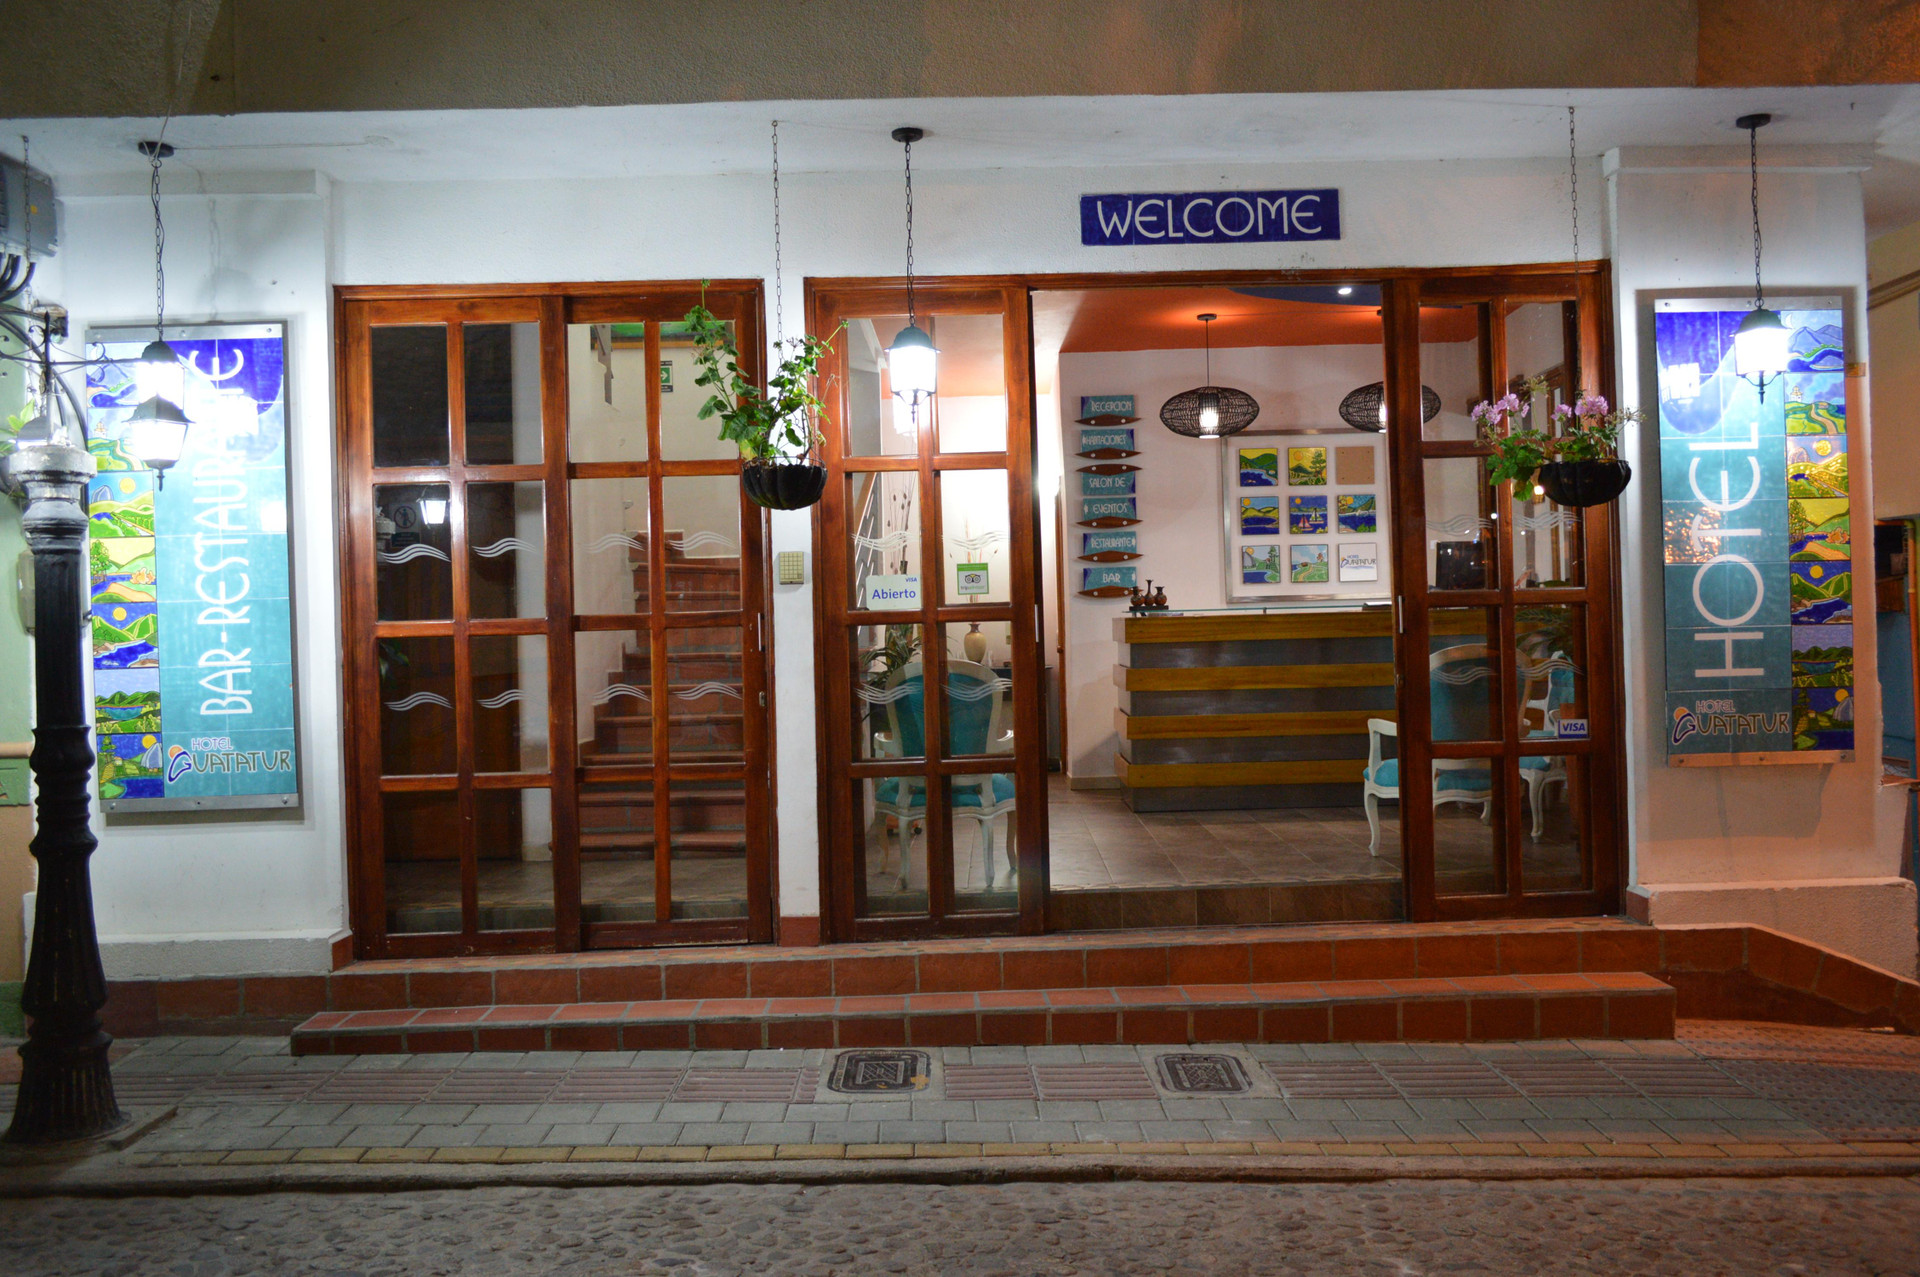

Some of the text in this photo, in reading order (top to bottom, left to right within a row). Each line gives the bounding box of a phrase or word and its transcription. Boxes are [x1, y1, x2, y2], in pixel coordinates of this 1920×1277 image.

[1097, 195, 1322, 239] WELCOME
[1115, 477, 1126, 487] DE
[1092, 503, 1128, 514] EVENTOS
[1688, 422, 1764, 678] HOTEL
[1103, 573, 1121, 583] BAR
[872, 589, 916, 599] Abierto
[1696, 700, 1736, 713] HOTEL
[1562, 722, 1586, 732] VISA
[192, 737, 233, 750] HOTEL
[168, 750, 292, 783] GUATATUR
